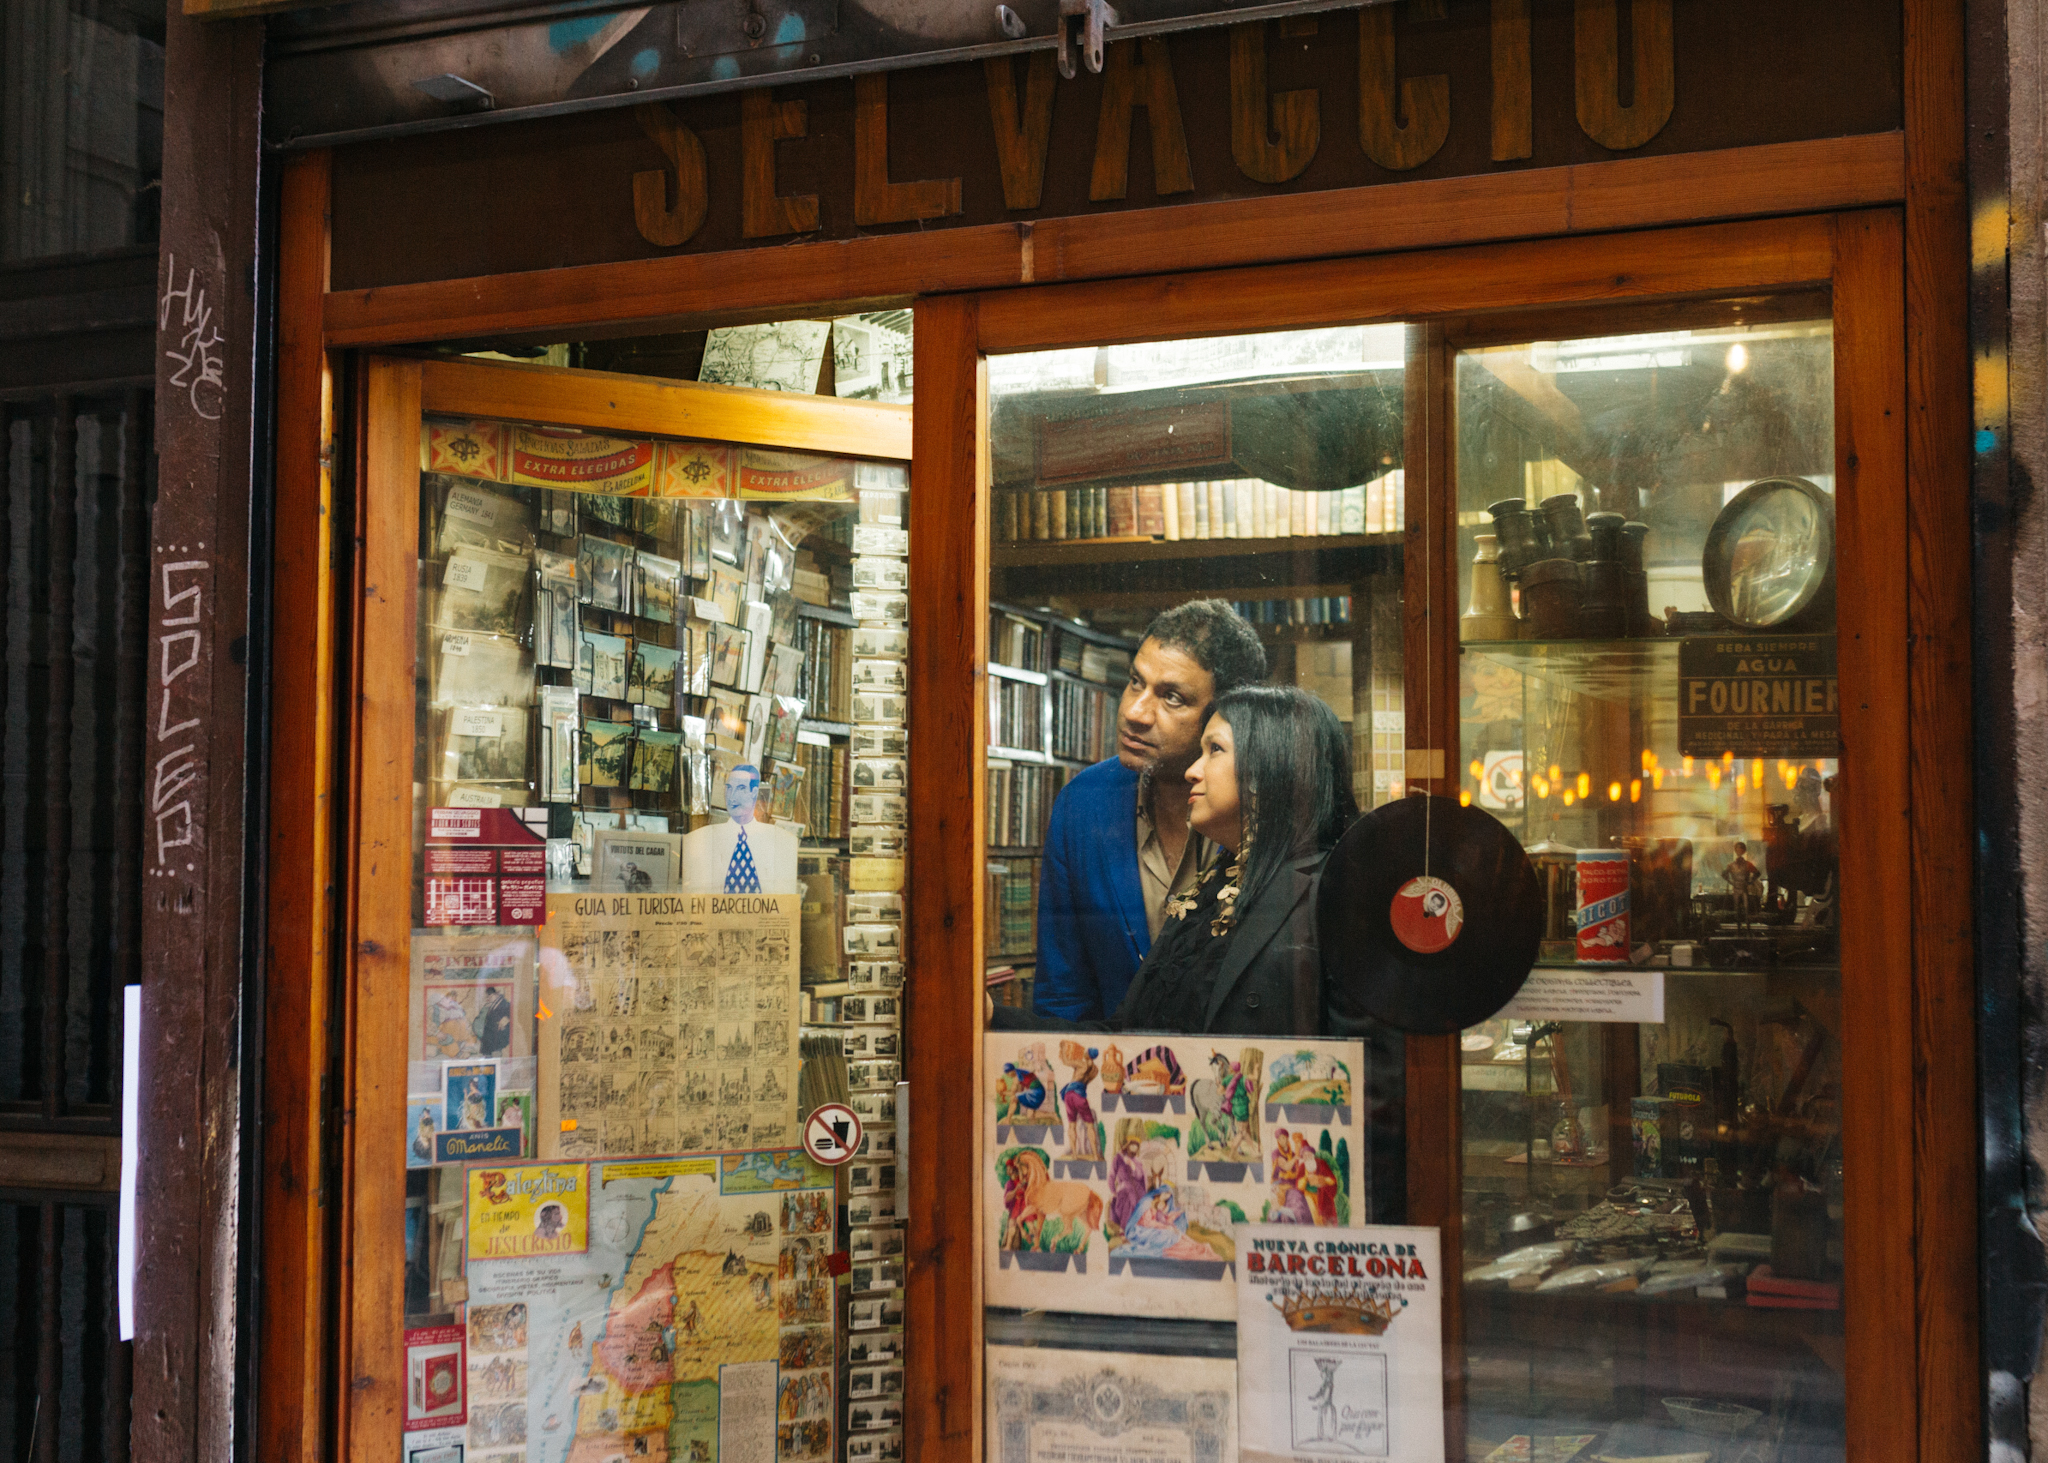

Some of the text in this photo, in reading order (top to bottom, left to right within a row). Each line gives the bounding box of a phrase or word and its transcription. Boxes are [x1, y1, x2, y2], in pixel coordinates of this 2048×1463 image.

[518, 431, 610, 457] ANCHOAS SALADAS
[524, 454, 636, 475] EXTRA ELEGIDAS
[750, 475, 789, 487] EXTRA
[451, 492, 483, 507] ALEMANIA
[450, 501, 480, 515] GERMANY
[452, 563, 472, 573] RUSIA
[452, 573, 468, 583] 1839
[1756, 642, 1817, 652] SIEMPRE
[1736, 658, 1798, 673] AGUA
[1688, 679, 1838, 714] FOURNIER
[463, 715, 495, 724] PALESTINA
[1745, 722, 1758, 730] LA
[1763, 732, 1790, 740] PARA
[460, 793, 493, 804] AUSTRALIA
[611, 845, 665, 856] VIRTUTS DEL CAGAR
[575, 897, 780, 916] GUIA DEL TURISTA EN BARCELONA
[1668, 1091, 1701, 1102] FUTUROLA
[446, 1135, 511, 1155] Manelic
[480, 1210, 520, 1223] EN TIEMPO
[499, 1223, 510, 1234] de
[485, 1232, 572, 1255] JESUCRISTO
[1252, 1239, 1418, 1257] NUEVA CRÓNICA DE
[1247, 1252, 1429, 1280] BARCELONA
